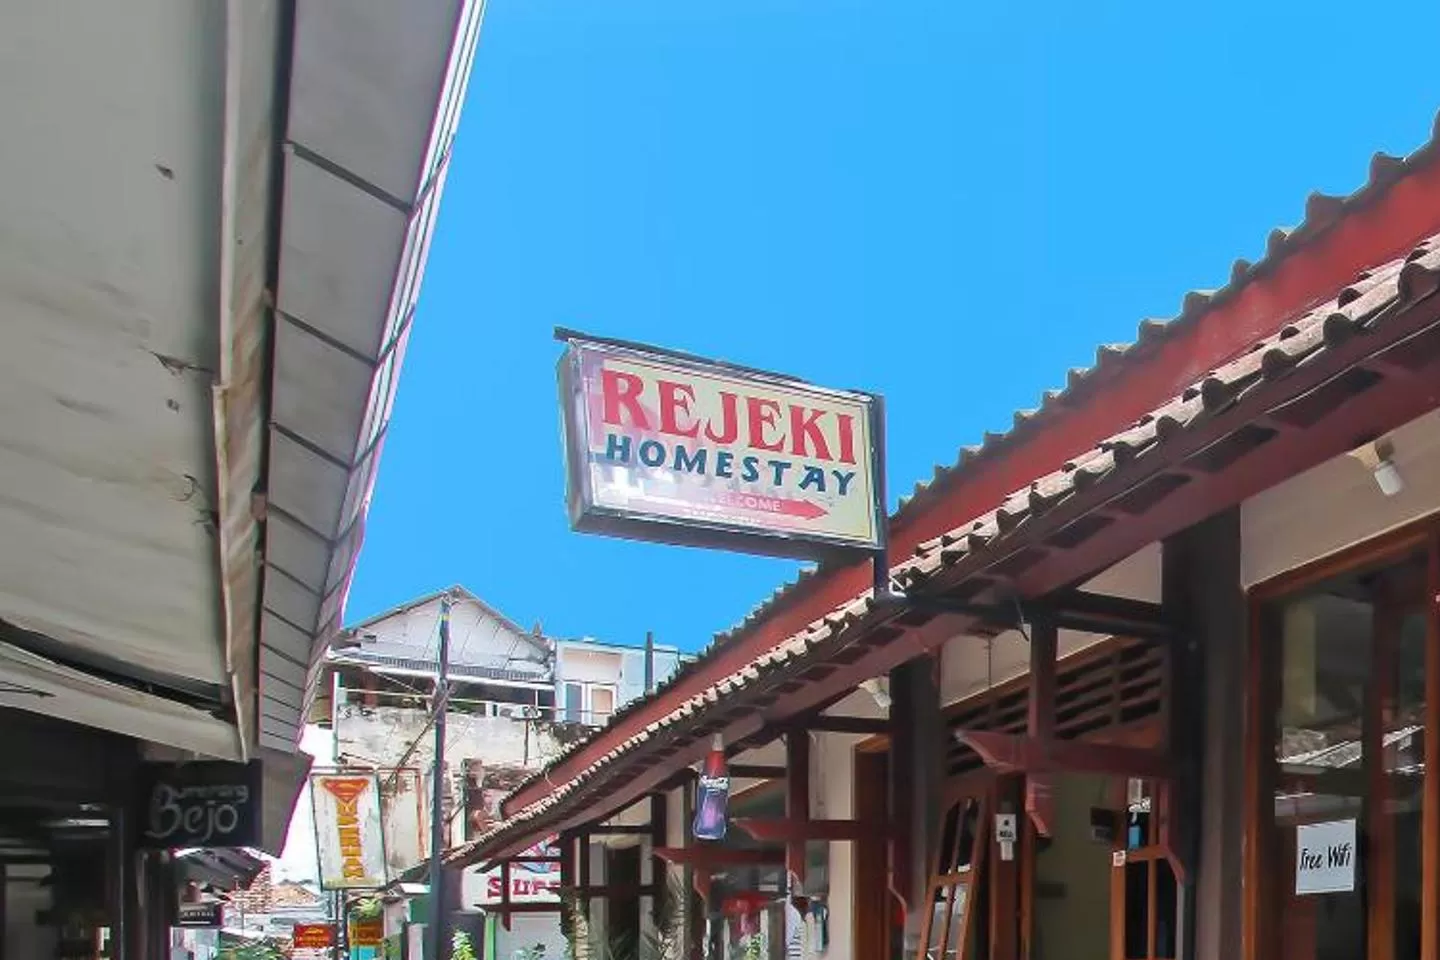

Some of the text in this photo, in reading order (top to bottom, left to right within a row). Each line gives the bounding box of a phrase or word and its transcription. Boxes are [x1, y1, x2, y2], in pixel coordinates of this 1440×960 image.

[600, 367, 856, 465] REJEKI
[605, 434, 855, 496] HOMESTAY
[709, 493, 783, 513] ELCOME
